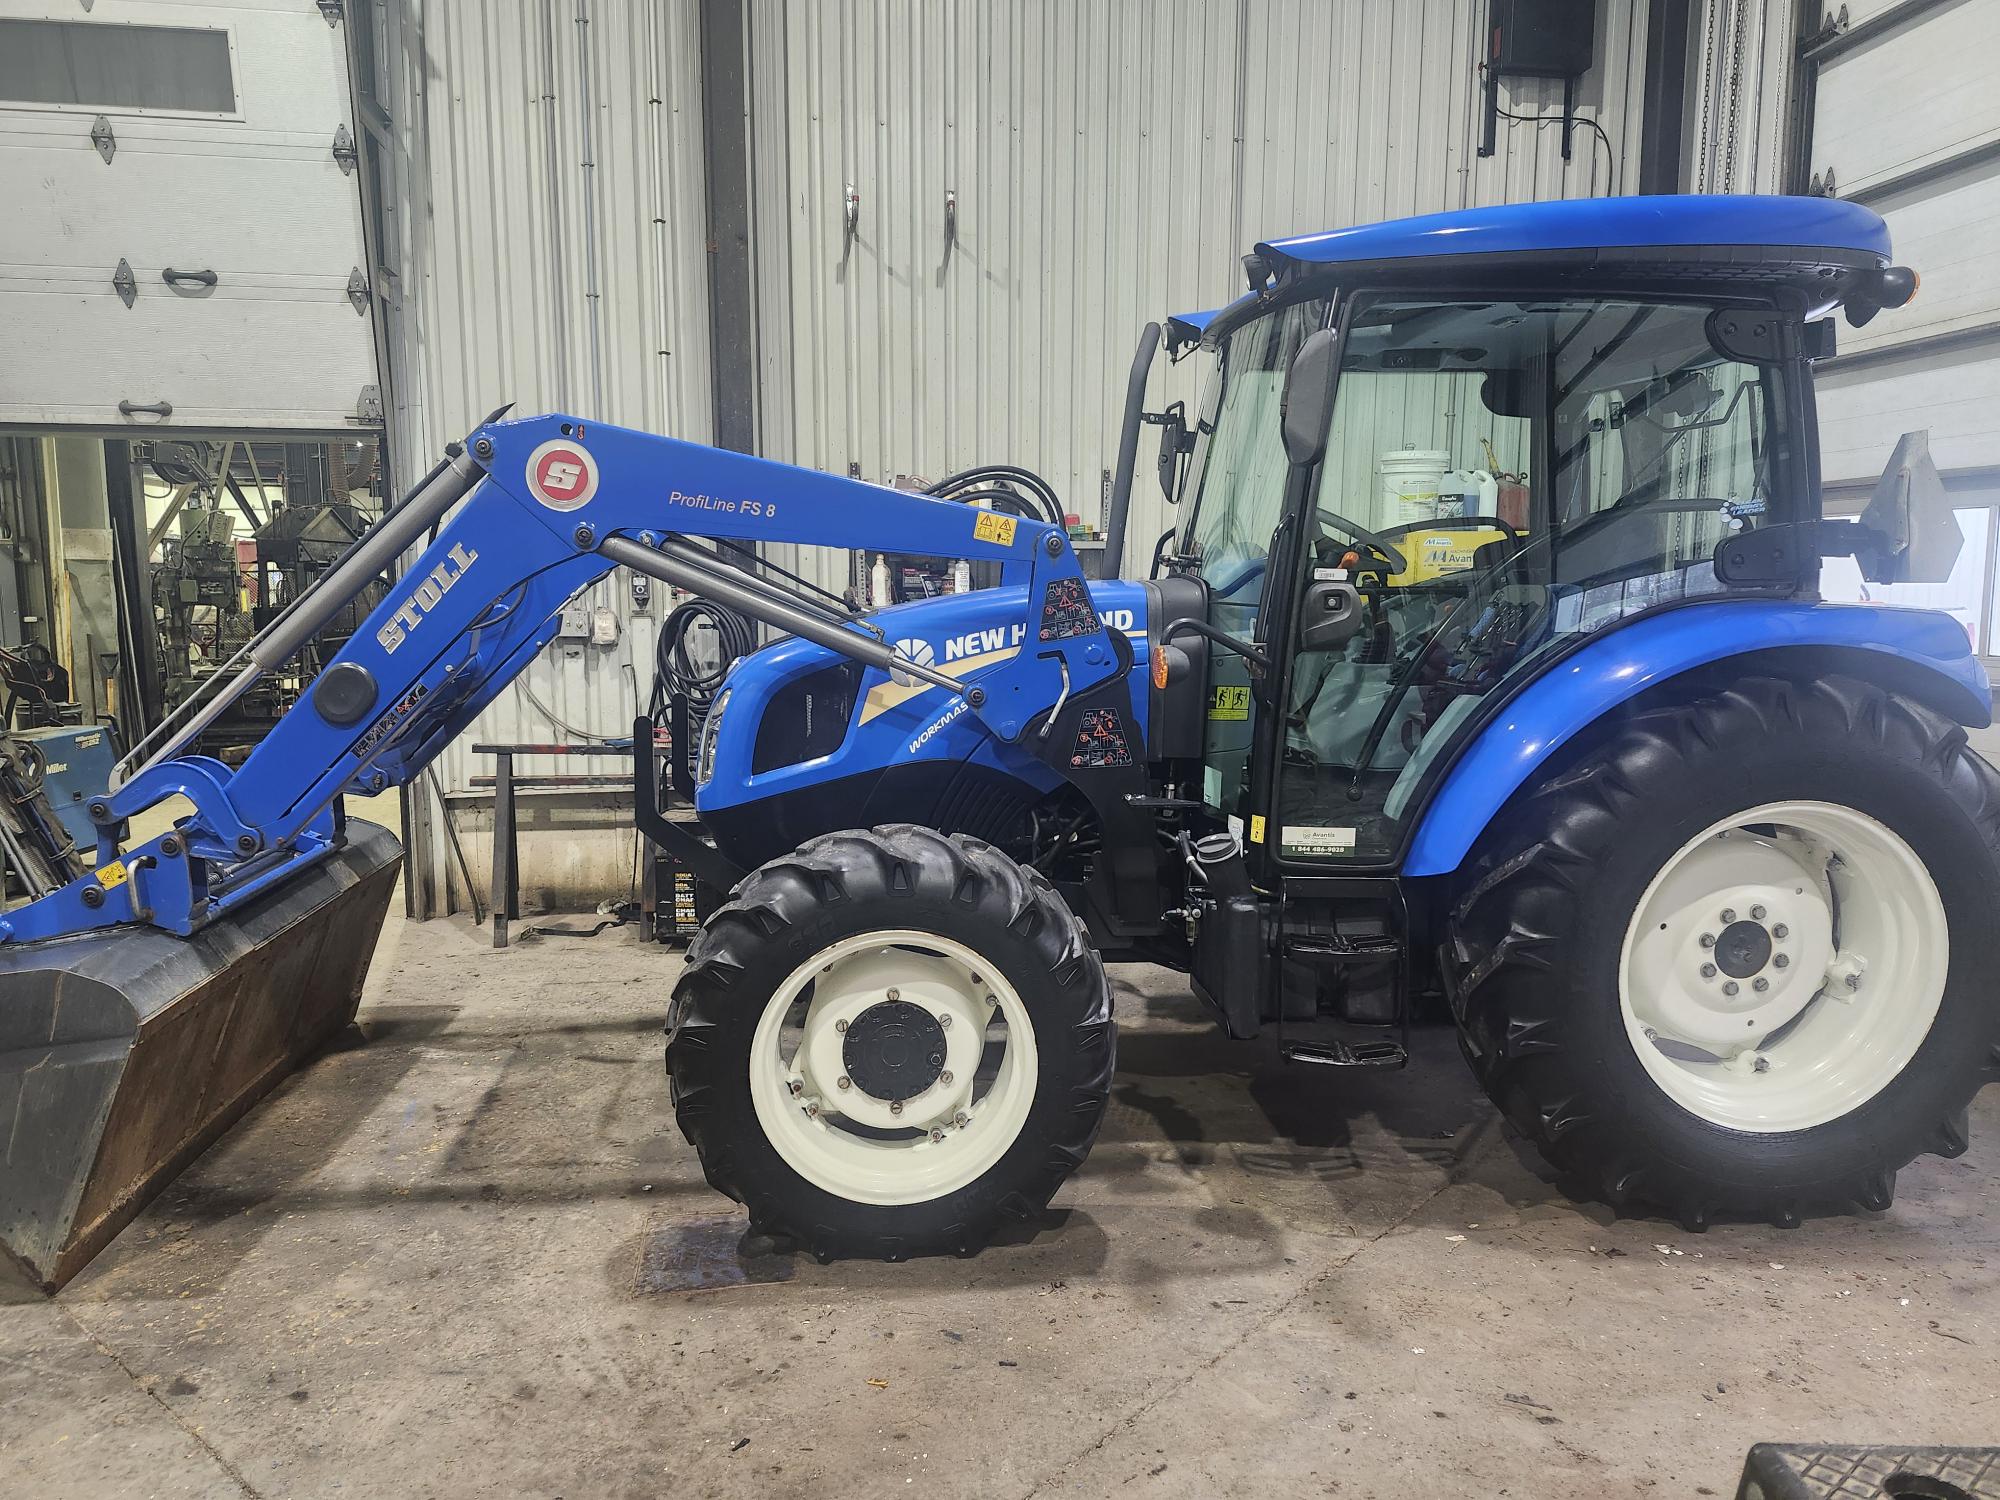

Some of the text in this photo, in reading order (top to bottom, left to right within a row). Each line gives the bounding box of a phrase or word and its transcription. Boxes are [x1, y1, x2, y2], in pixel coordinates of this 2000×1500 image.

[668, 491, 776, 518] ProfiLine FS 8
[1449, 554, 1472, 563] Avan
[376, 541, 479, 655] STOLL
[945, 626, 1006, 661] NEW
[909, 702, 969, 753] WORKMAS
